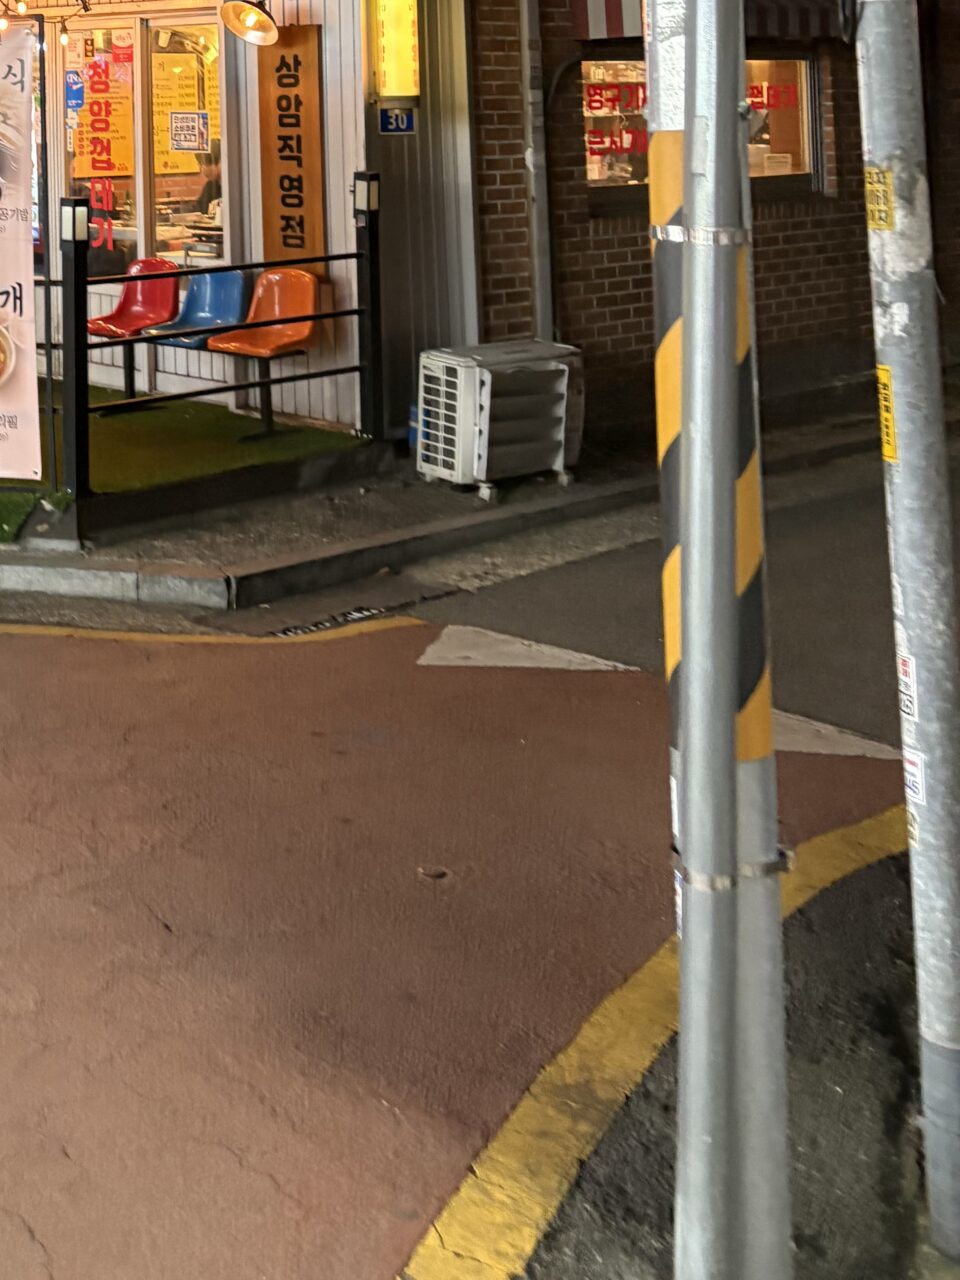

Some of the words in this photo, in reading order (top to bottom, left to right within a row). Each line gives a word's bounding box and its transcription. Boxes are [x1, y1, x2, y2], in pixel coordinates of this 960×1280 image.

[88, 60, 116, 251] 청양껍데기
[275, 54, 305, 249] 상암직영점
[387, 110, 407, 129] 30
